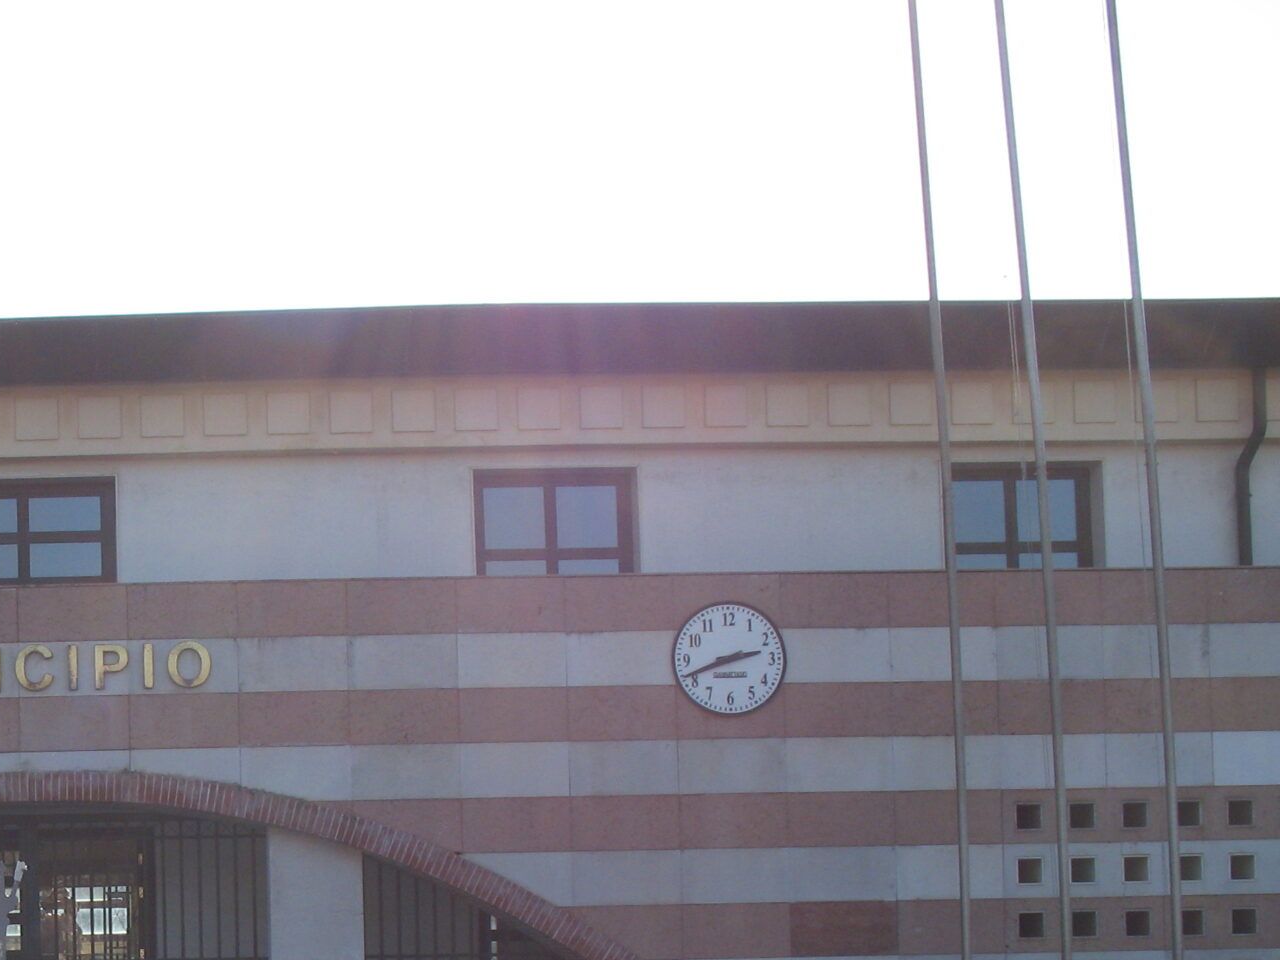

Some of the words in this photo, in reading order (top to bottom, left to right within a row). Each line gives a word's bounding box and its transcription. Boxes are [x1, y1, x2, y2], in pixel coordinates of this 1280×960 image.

[702, 618, 714, 633] 11
[722, 612, 736, 627] 12
[747, 618, 753, 632] 1
[688, 633, 701, 648] 10
[762, 632, 769, 647] 2
[683, 653, 691, 668] 9
[768, 652, 776, 666] 3
[691, 673, 699, 689] 8
[761, 673, 768, 687] 4
[706, 686, 713, 701] 7
[727, 691, 735, 706] 6
[748, 686, 756, 700] 5
